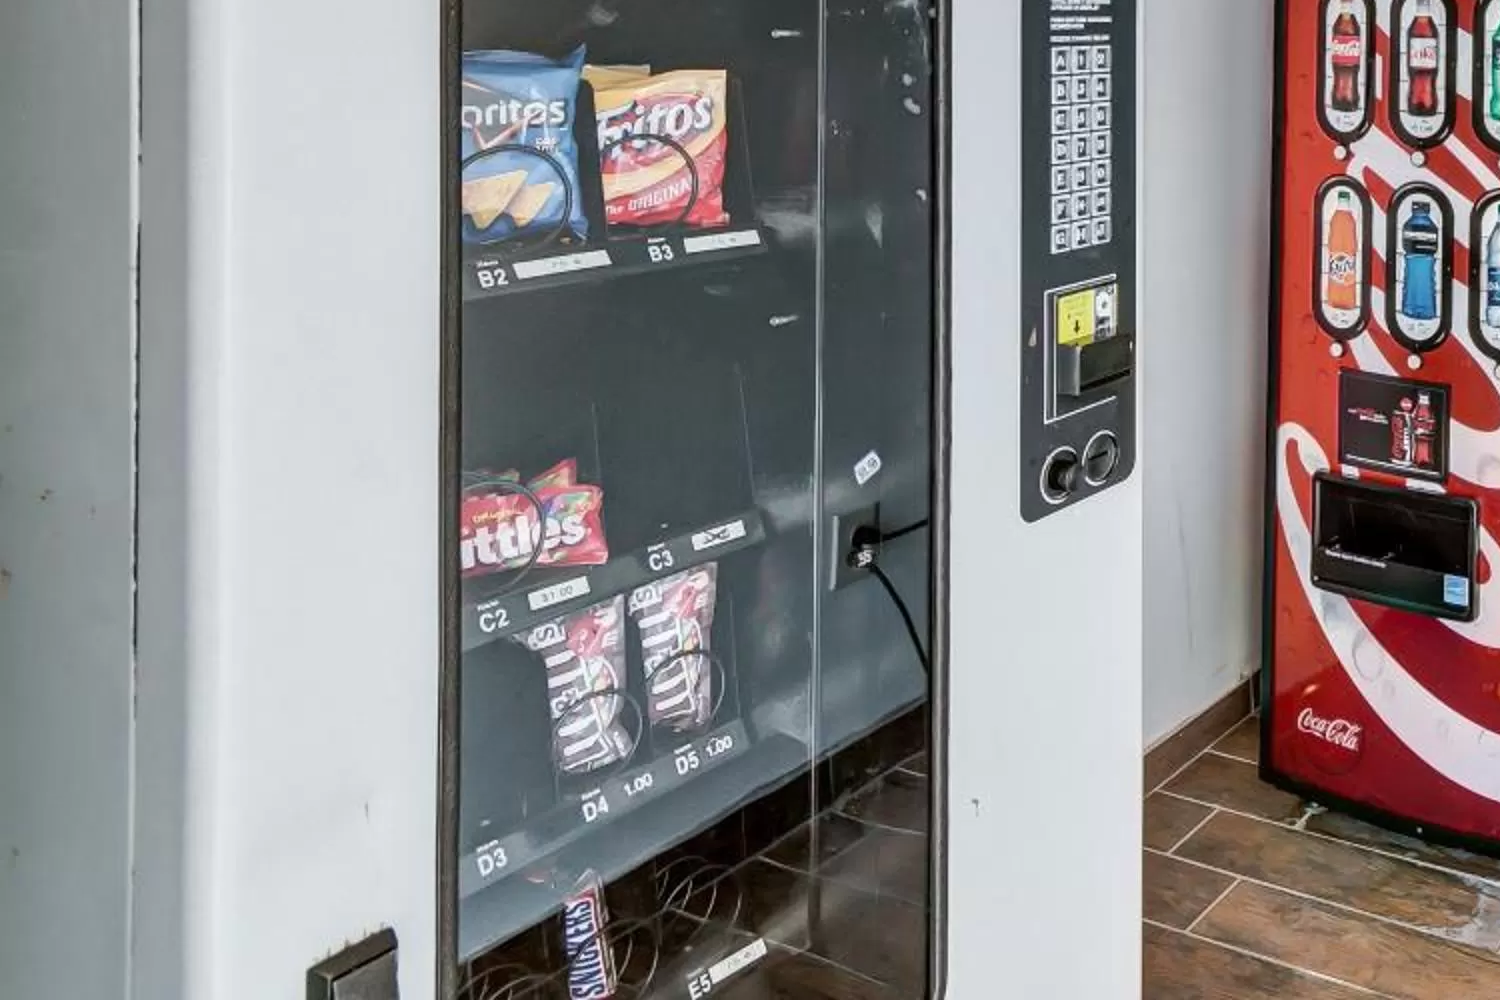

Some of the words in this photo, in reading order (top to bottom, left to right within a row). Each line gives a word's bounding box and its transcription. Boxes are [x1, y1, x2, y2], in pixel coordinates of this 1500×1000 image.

[462, 99, 566, 127] oritos
[598, 97, 713, 150] Fritos
[648, 244, 675, 263] B3
[477, 268, 509, 289] B2
[461, 514, 587, 570] ittles
[649, 550, 674, 571] C3
[478, 609, 510, 633] C2
[1297, 707, 1361, 752] Coca-Cola
[674, 750, 700, 776] D5
[705, 734, 733, 758] 1.00
[582, 794, 609, 823] D4
[623, 772, 653, 798] 1.00
[477, 846, 509, 878] D3
[565, 899, 605, 998] SNICKERS
[687, 972, 712, 1000] E5
